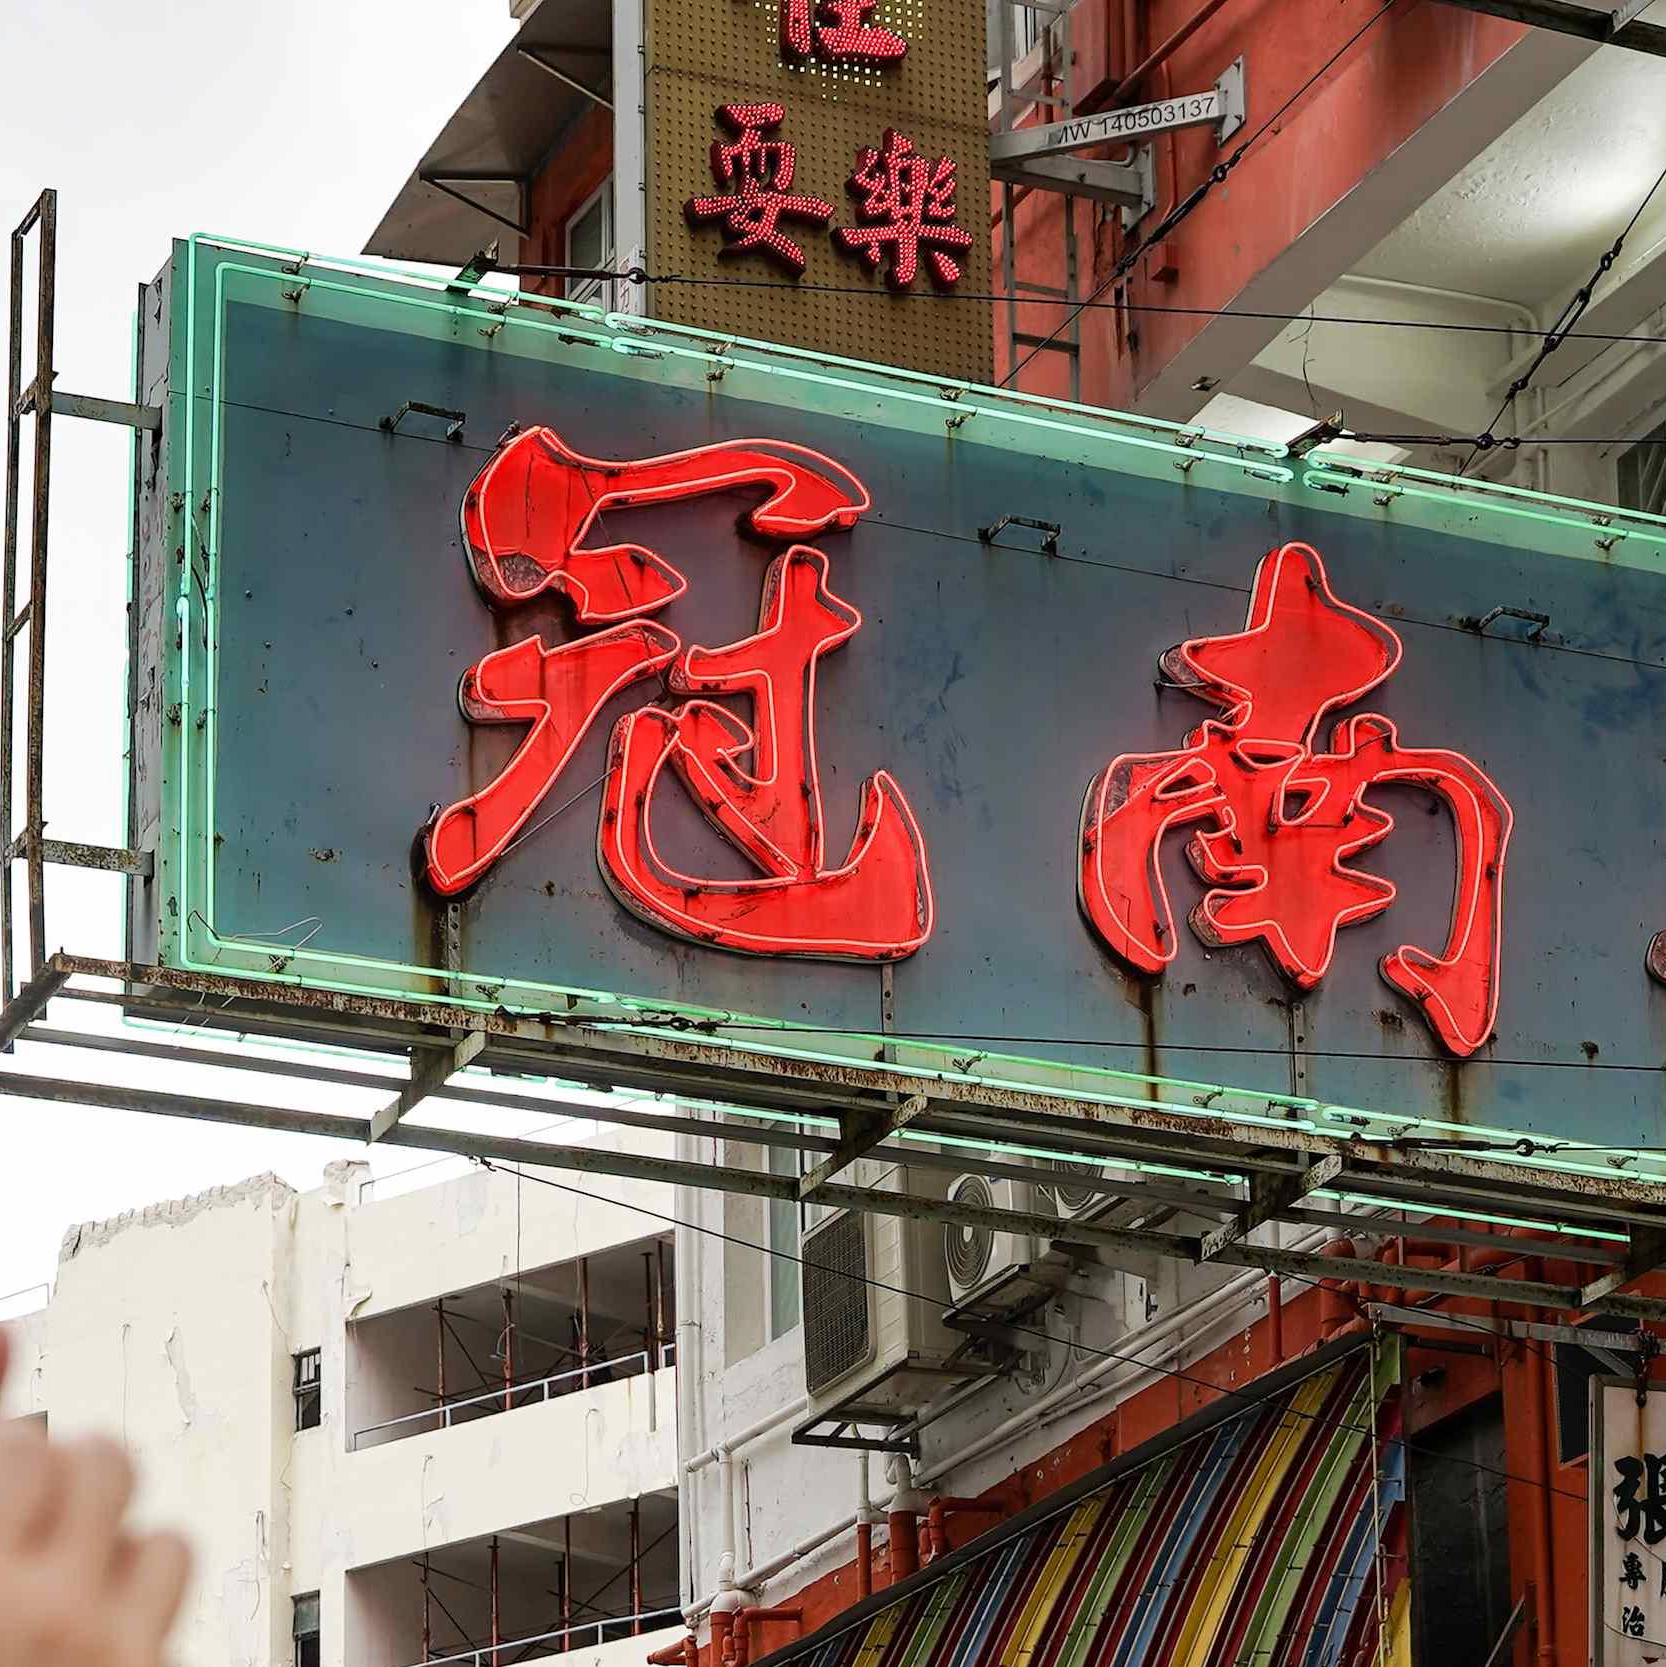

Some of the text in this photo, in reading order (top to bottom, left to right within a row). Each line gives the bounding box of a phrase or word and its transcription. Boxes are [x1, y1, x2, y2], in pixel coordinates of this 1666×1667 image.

[1100, 96, 1215, 136] 140503137
[684, 102, 974, 288] 耍樂
[1619, 1551, 1647, 1638] 專治
